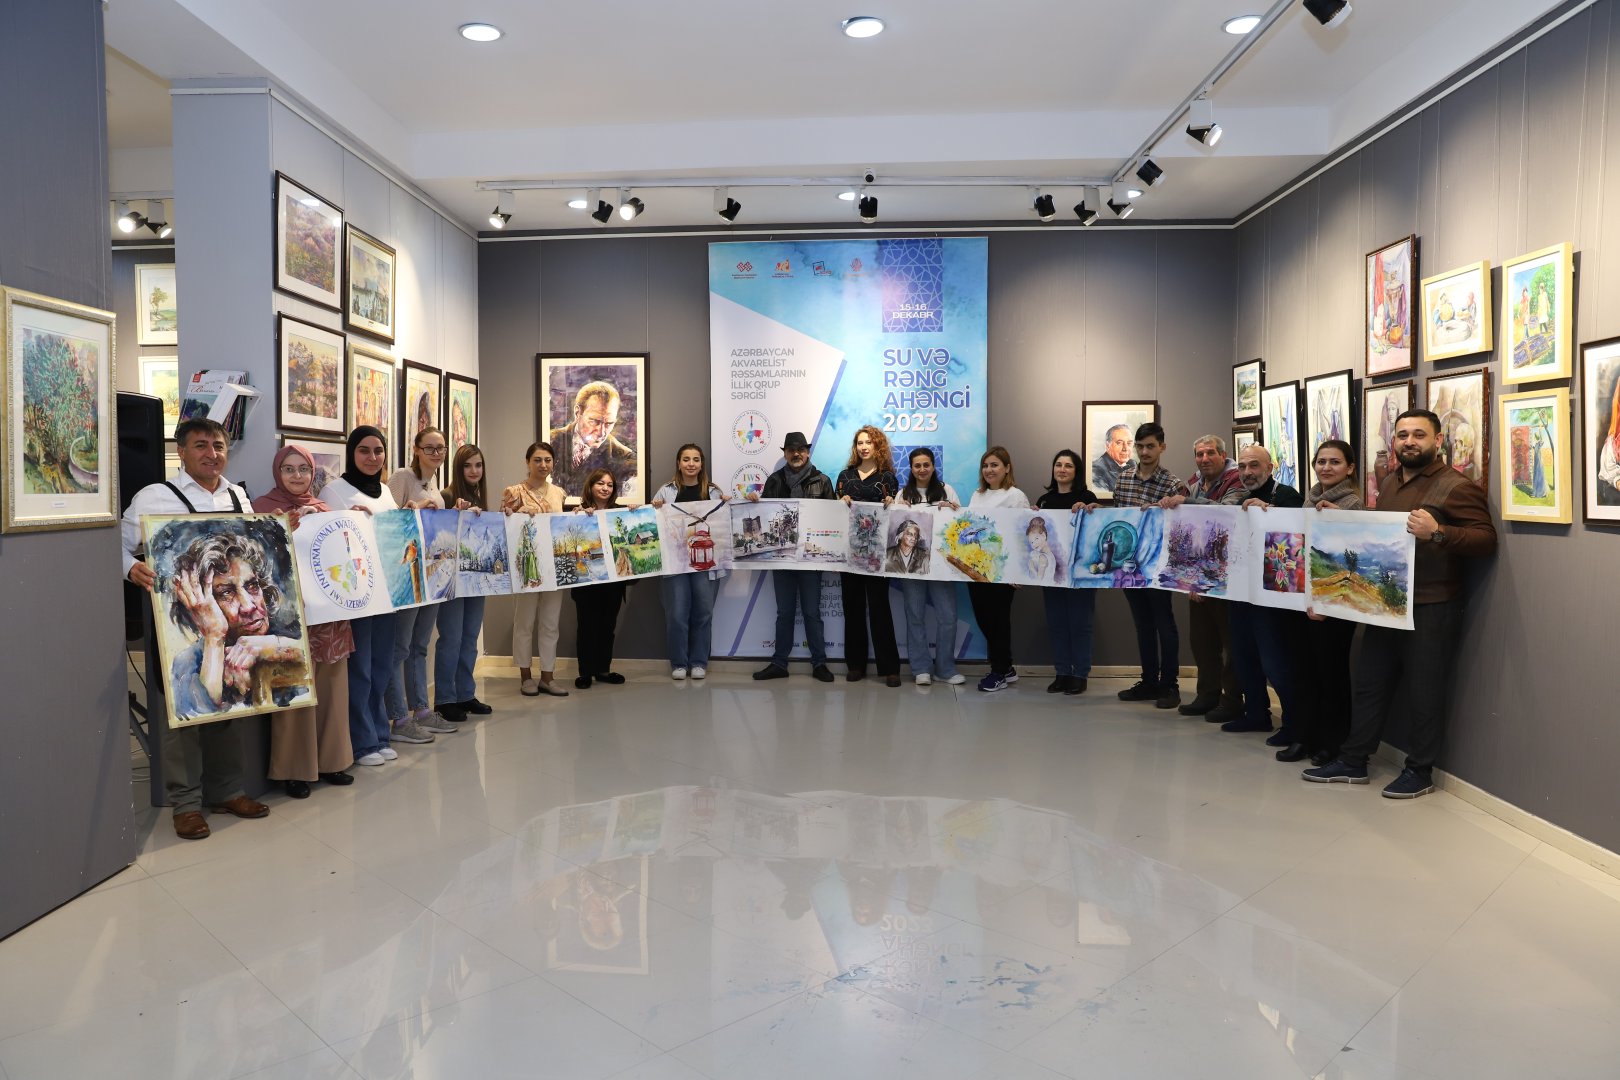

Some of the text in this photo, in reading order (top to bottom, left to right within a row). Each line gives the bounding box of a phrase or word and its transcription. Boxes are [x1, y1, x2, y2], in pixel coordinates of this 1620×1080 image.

[899, 303, 927, 311] 15-16
[892, 311, 934, 319] DEKABR
[730, 347, 795, 357] AZƏRBAYCAN
[883, 348, 950, 367] SU VƏ
[730, 356, 787, 367] AKVARELİST
[731, 369, 806, 378] RƏSSAMLARININ
[883, 369, 948, 388] RƏNG
[731, 379, 781, 390] İLLİK QRUP
[730, 389, 766, 400] SƏRGİSİ
[883, 385, 971, 409] AHƏNGİ
[882, 412, 939, 432] 2023
[743, 473, 761, 482] IWS
[311, 524, 336, 589] INTERNATIONAL
[329, 589, 344, 605] IWS
